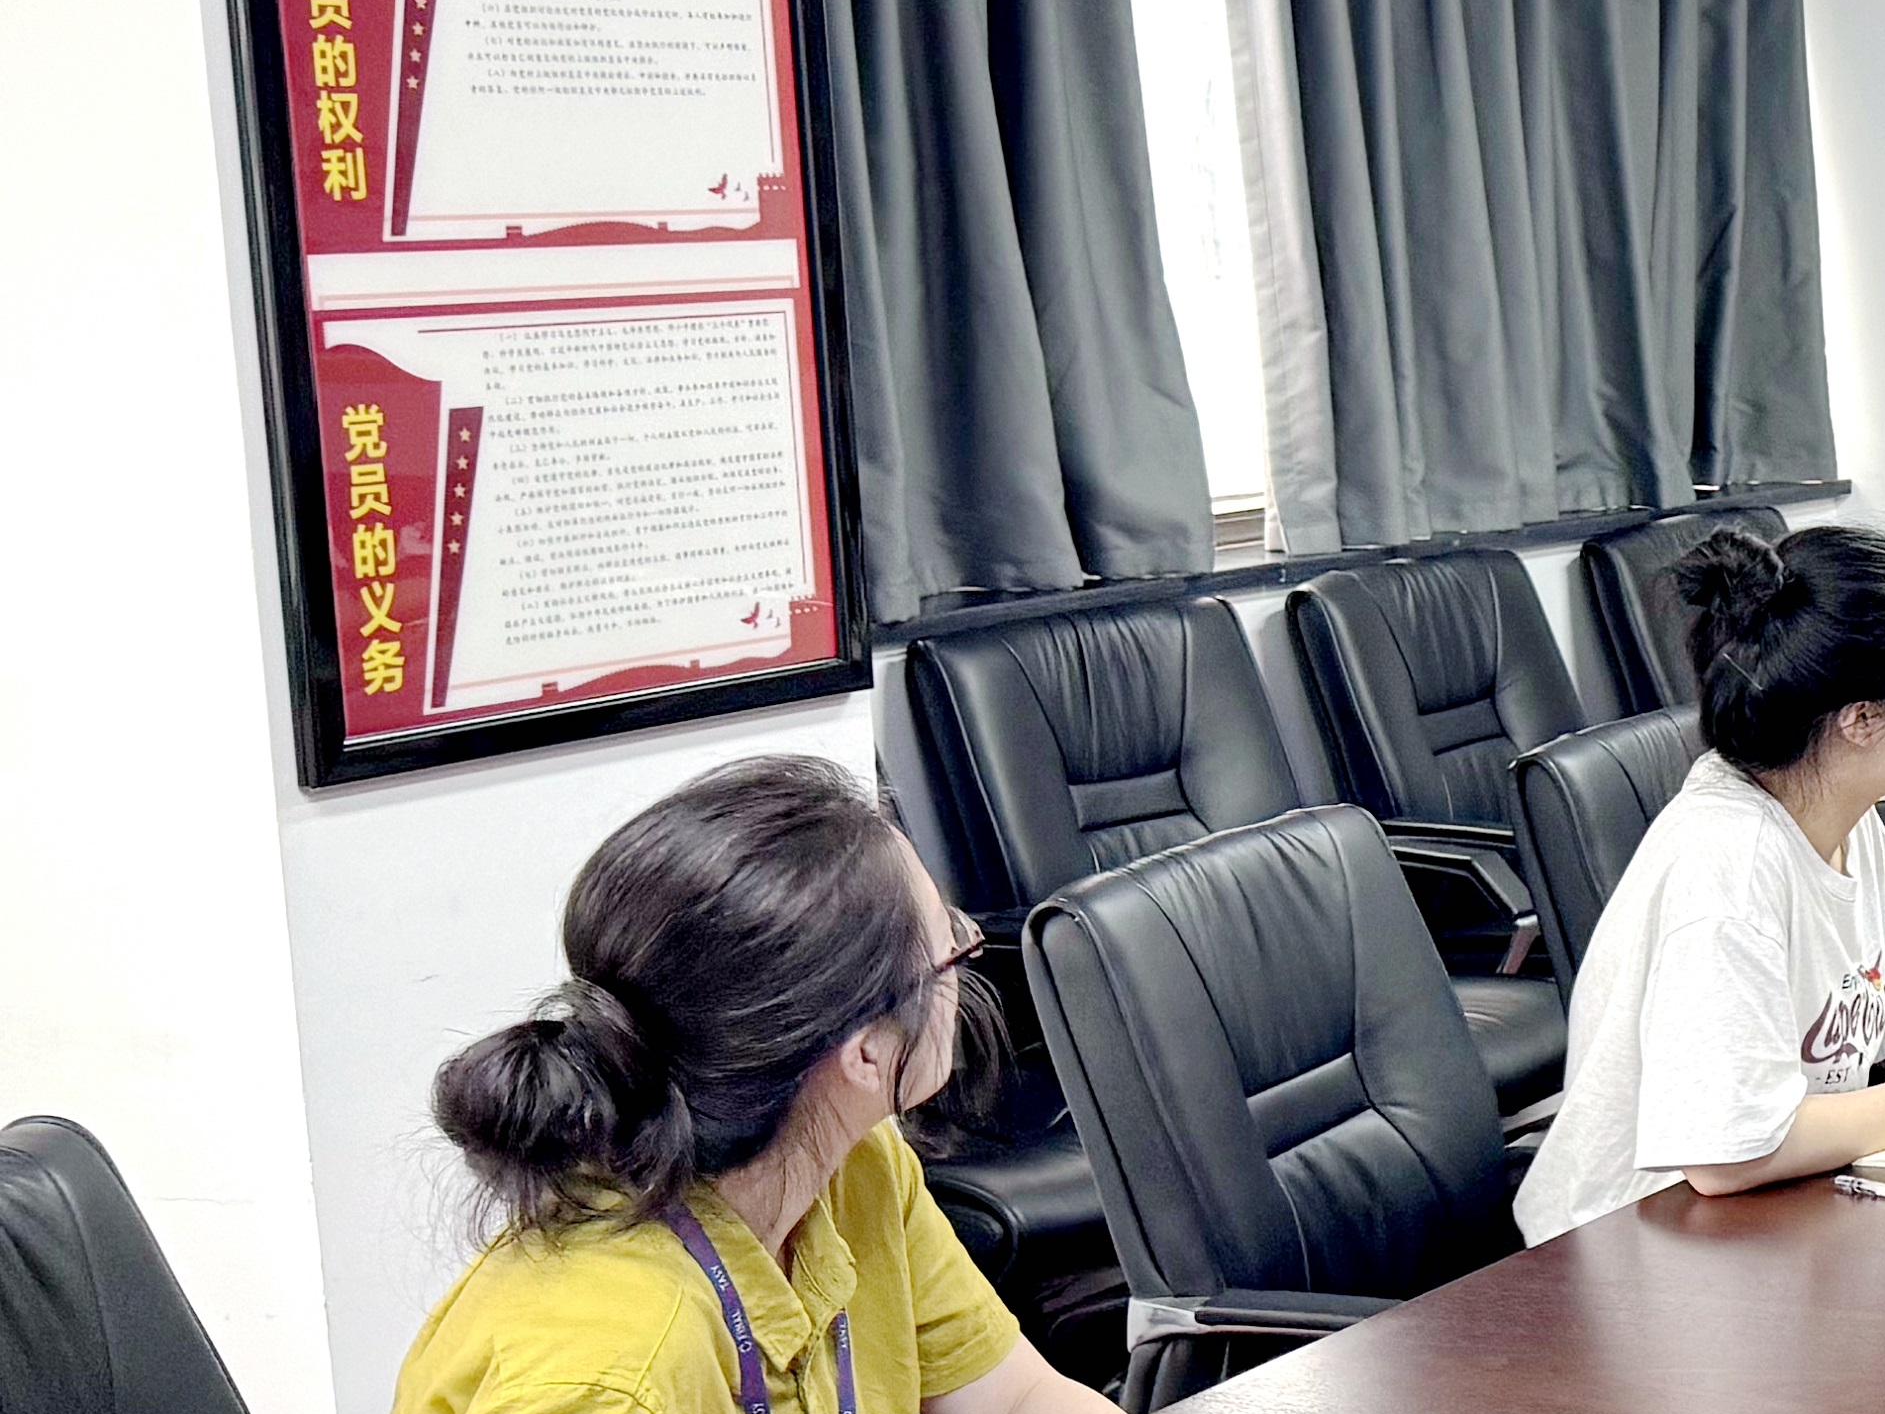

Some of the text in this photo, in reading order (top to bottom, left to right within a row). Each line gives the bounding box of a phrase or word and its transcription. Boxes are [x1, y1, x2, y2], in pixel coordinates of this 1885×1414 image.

[341, 404, 405, 694] 党员的义务
